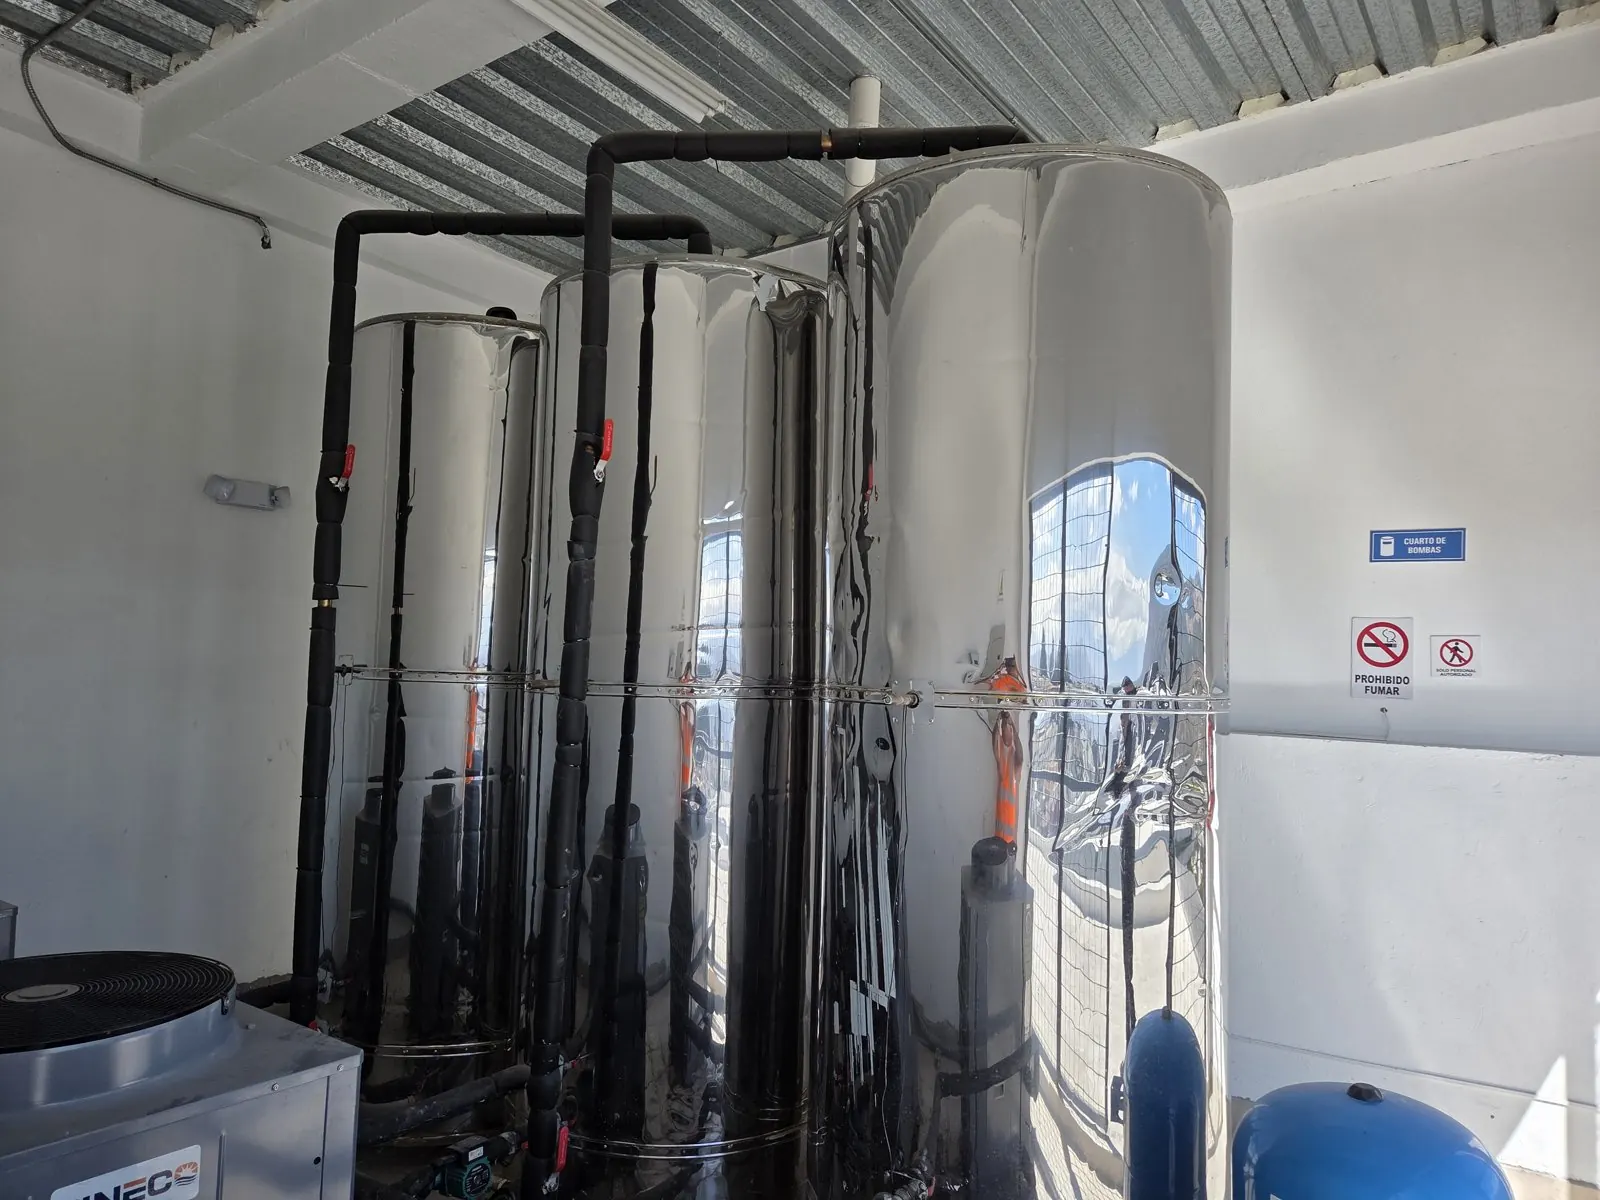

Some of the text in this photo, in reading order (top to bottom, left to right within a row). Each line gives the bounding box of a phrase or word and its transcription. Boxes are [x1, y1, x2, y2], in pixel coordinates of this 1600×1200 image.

[1404, 536, 1447, 545] CUARTO DE
[1408, 546, 1441, 554] BOMBAS
[1355, 674, 1410, 685] PROHIBIDO
[1364, 685, 1400, 696] FUMAR
